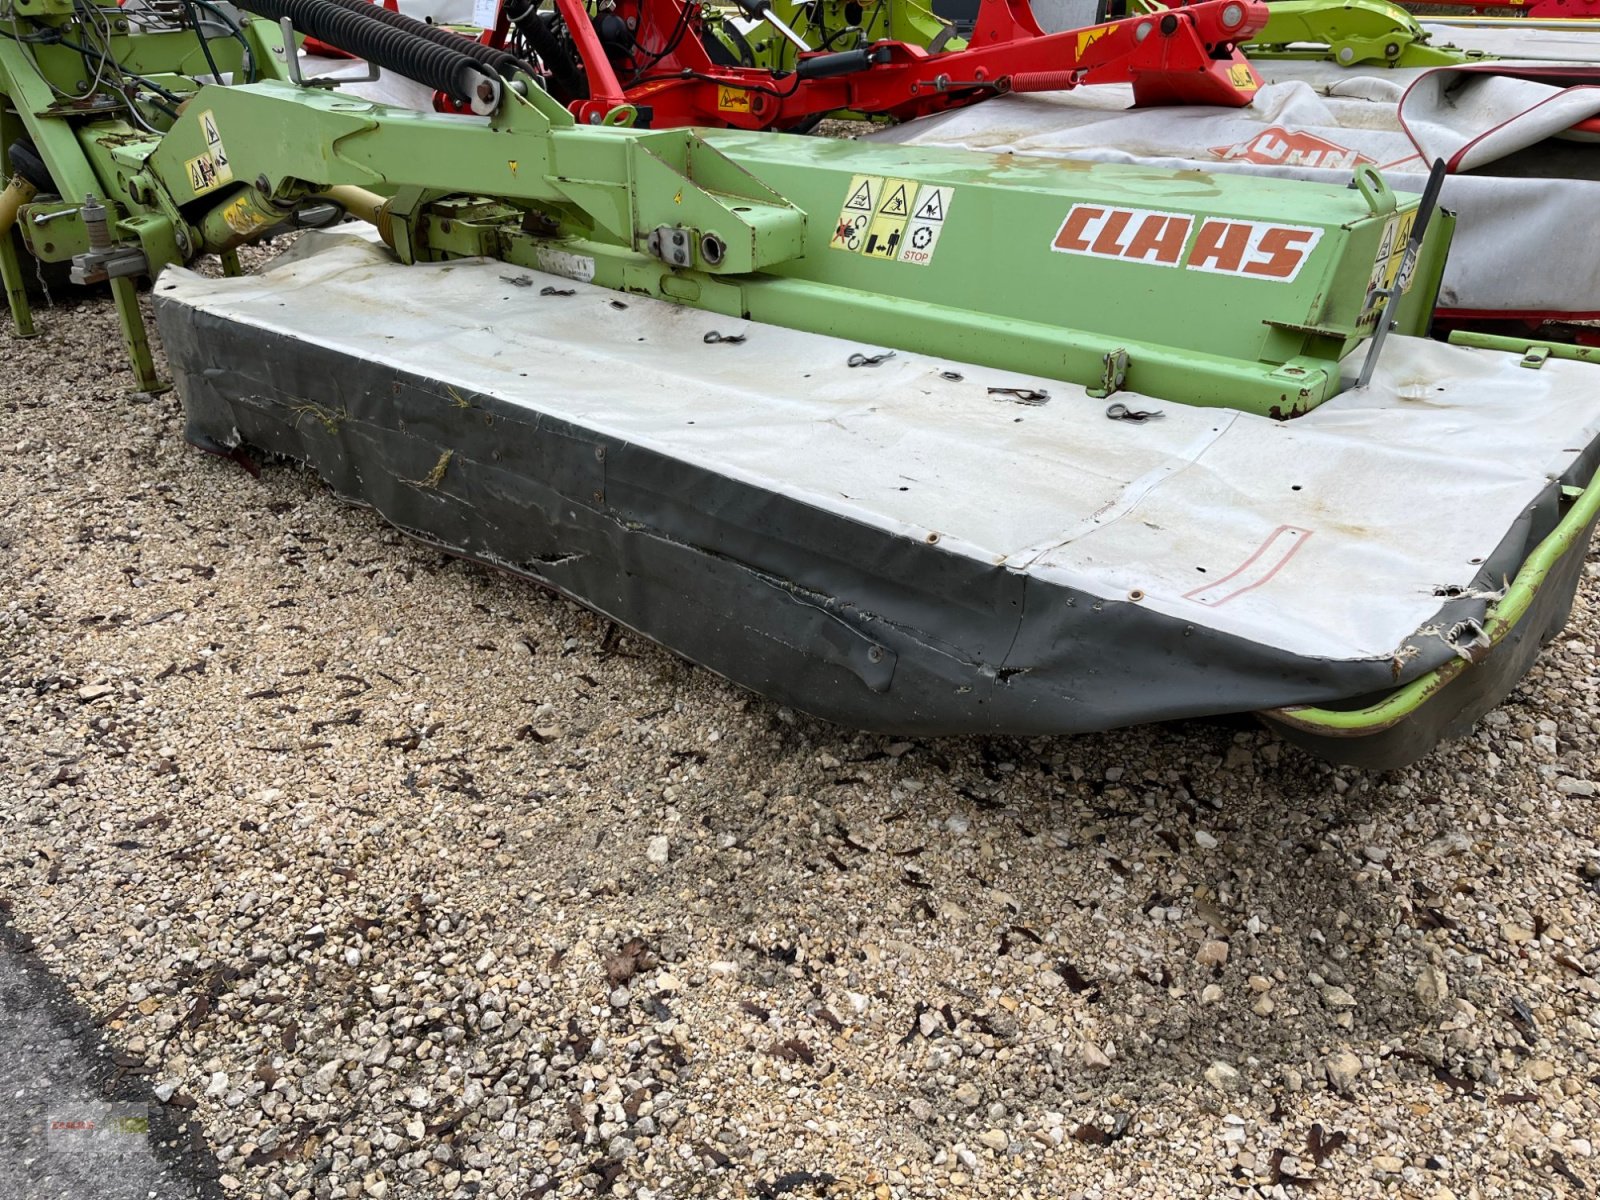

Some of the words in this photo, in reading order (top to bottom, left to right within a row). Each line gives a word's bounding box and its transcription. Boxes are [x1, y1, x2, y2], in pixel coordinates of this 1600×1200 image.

[1222, 134, 1360, 169] KUHN
[903, 250, 929, 262] STOP
[1053, 206, 1315, 278] CLAAS
